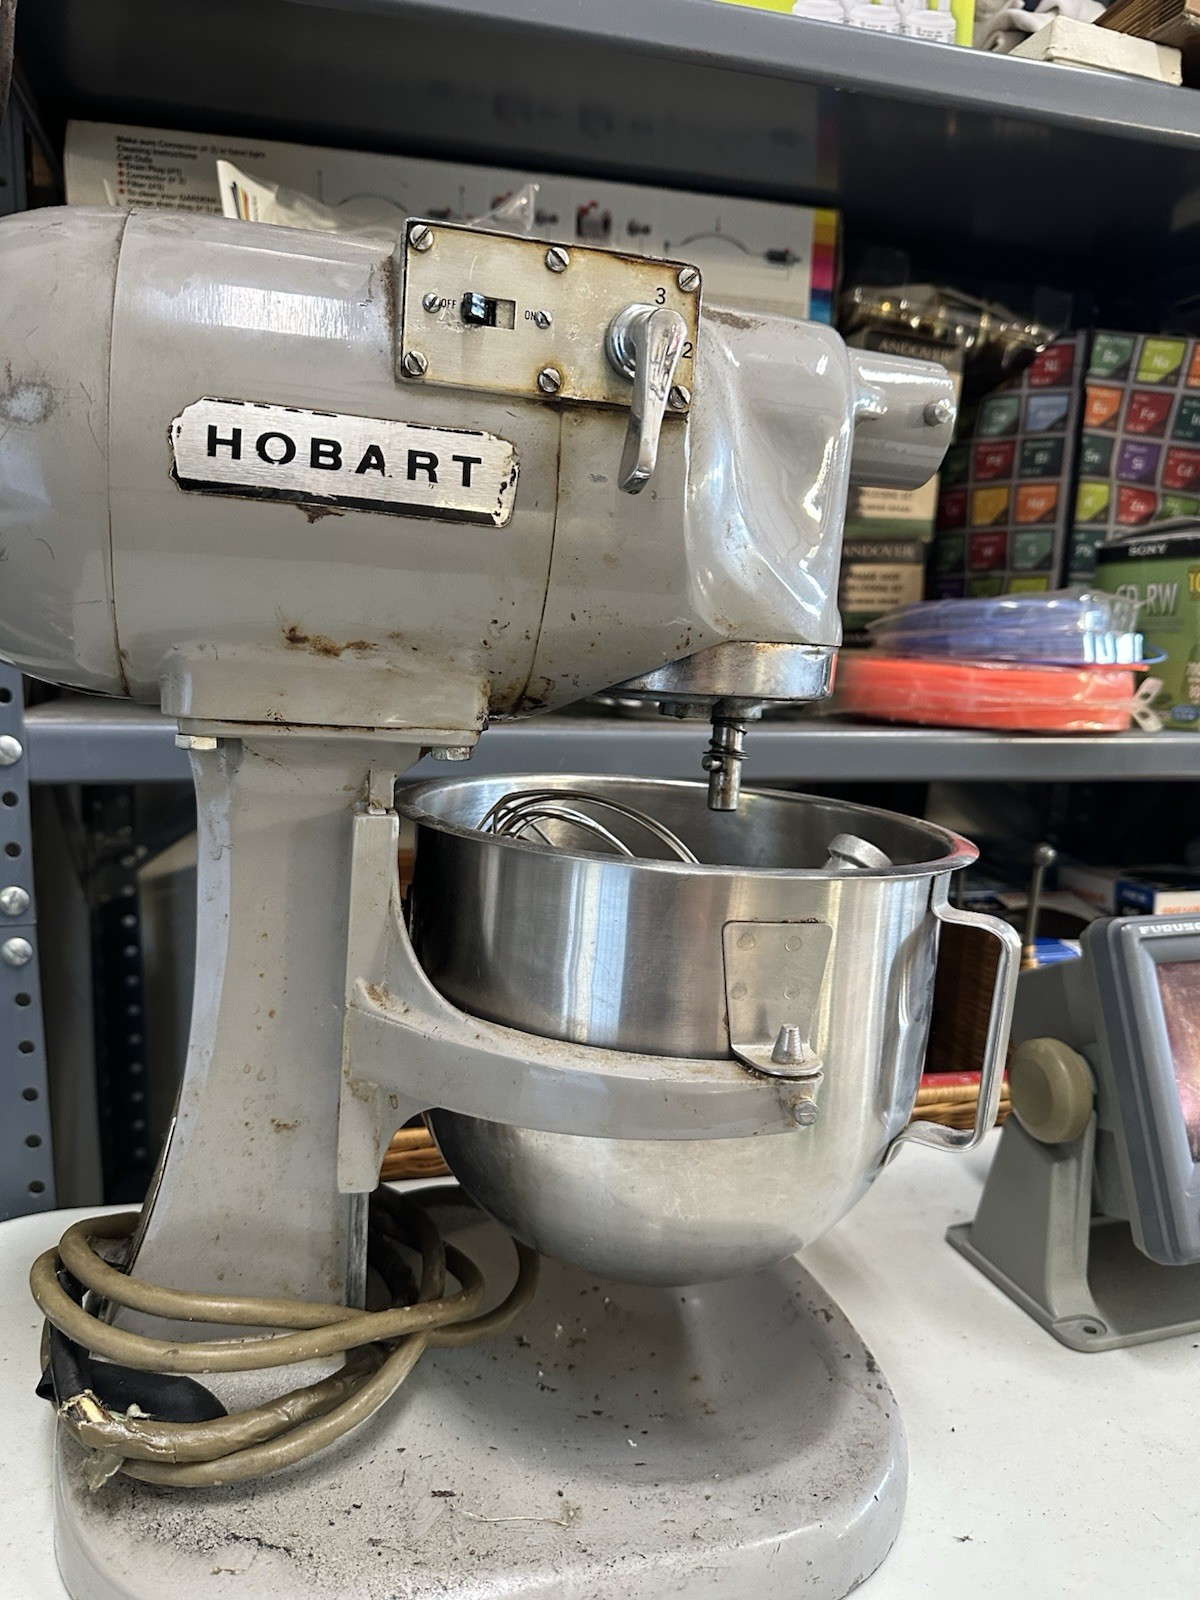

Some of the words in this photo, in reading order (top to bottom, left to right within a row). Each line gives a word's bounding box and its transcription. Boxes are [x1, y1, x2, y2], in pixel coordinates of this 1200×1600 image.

[440, 298, 457, 309] OFF
[655, 287, 666, 304] 3
[681, 342, 693, 358] 2
[206, 424, 482, 488] HOBART
[1128, 543, 1169, 557] SONY
